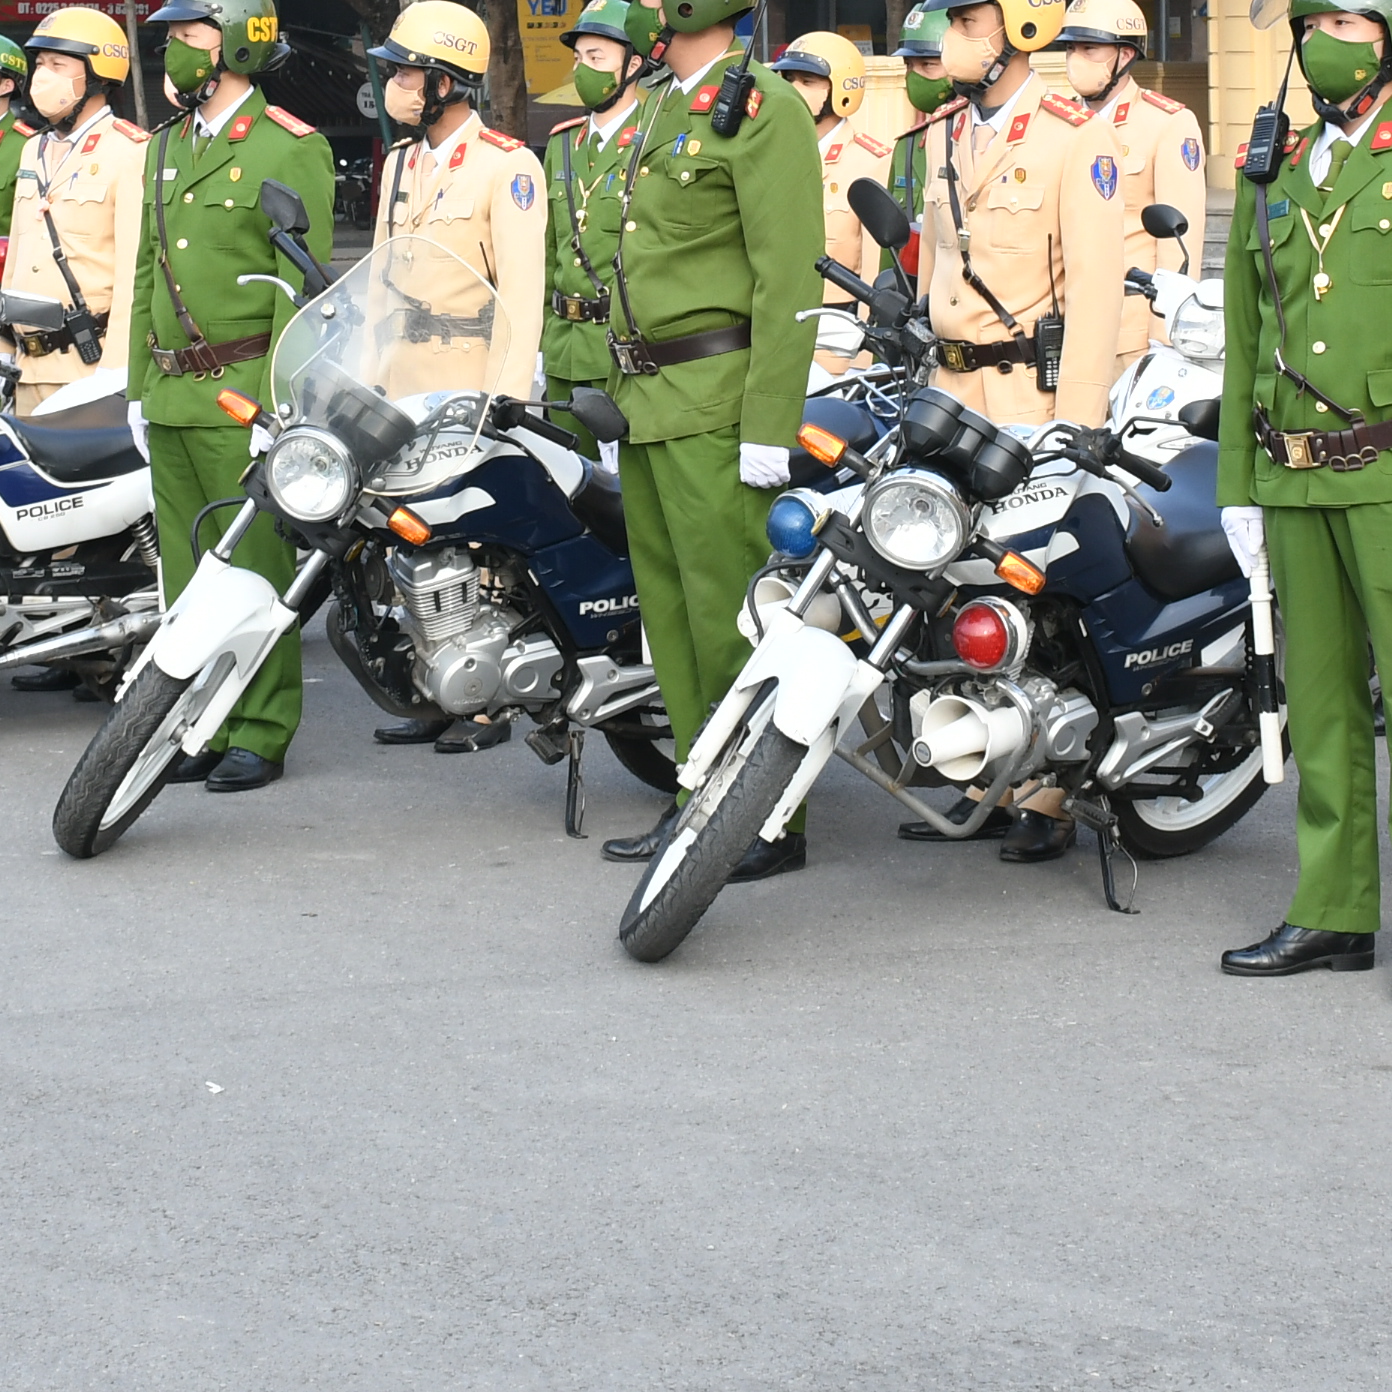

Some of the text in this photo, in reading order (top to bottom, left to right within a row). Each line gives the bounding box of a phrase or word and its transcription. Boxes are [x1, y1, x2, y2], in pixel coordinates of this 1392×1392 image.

[433, 30, 478, 56] CSGT
[404, 444, 485, 471] HONDA
[16, 496, 84, 521] POLICE
[992, 487, 1069, 516] HONDA
[579, 594, 639, 616] POLIC
[1123, 638, 1194, 669] POLICE
